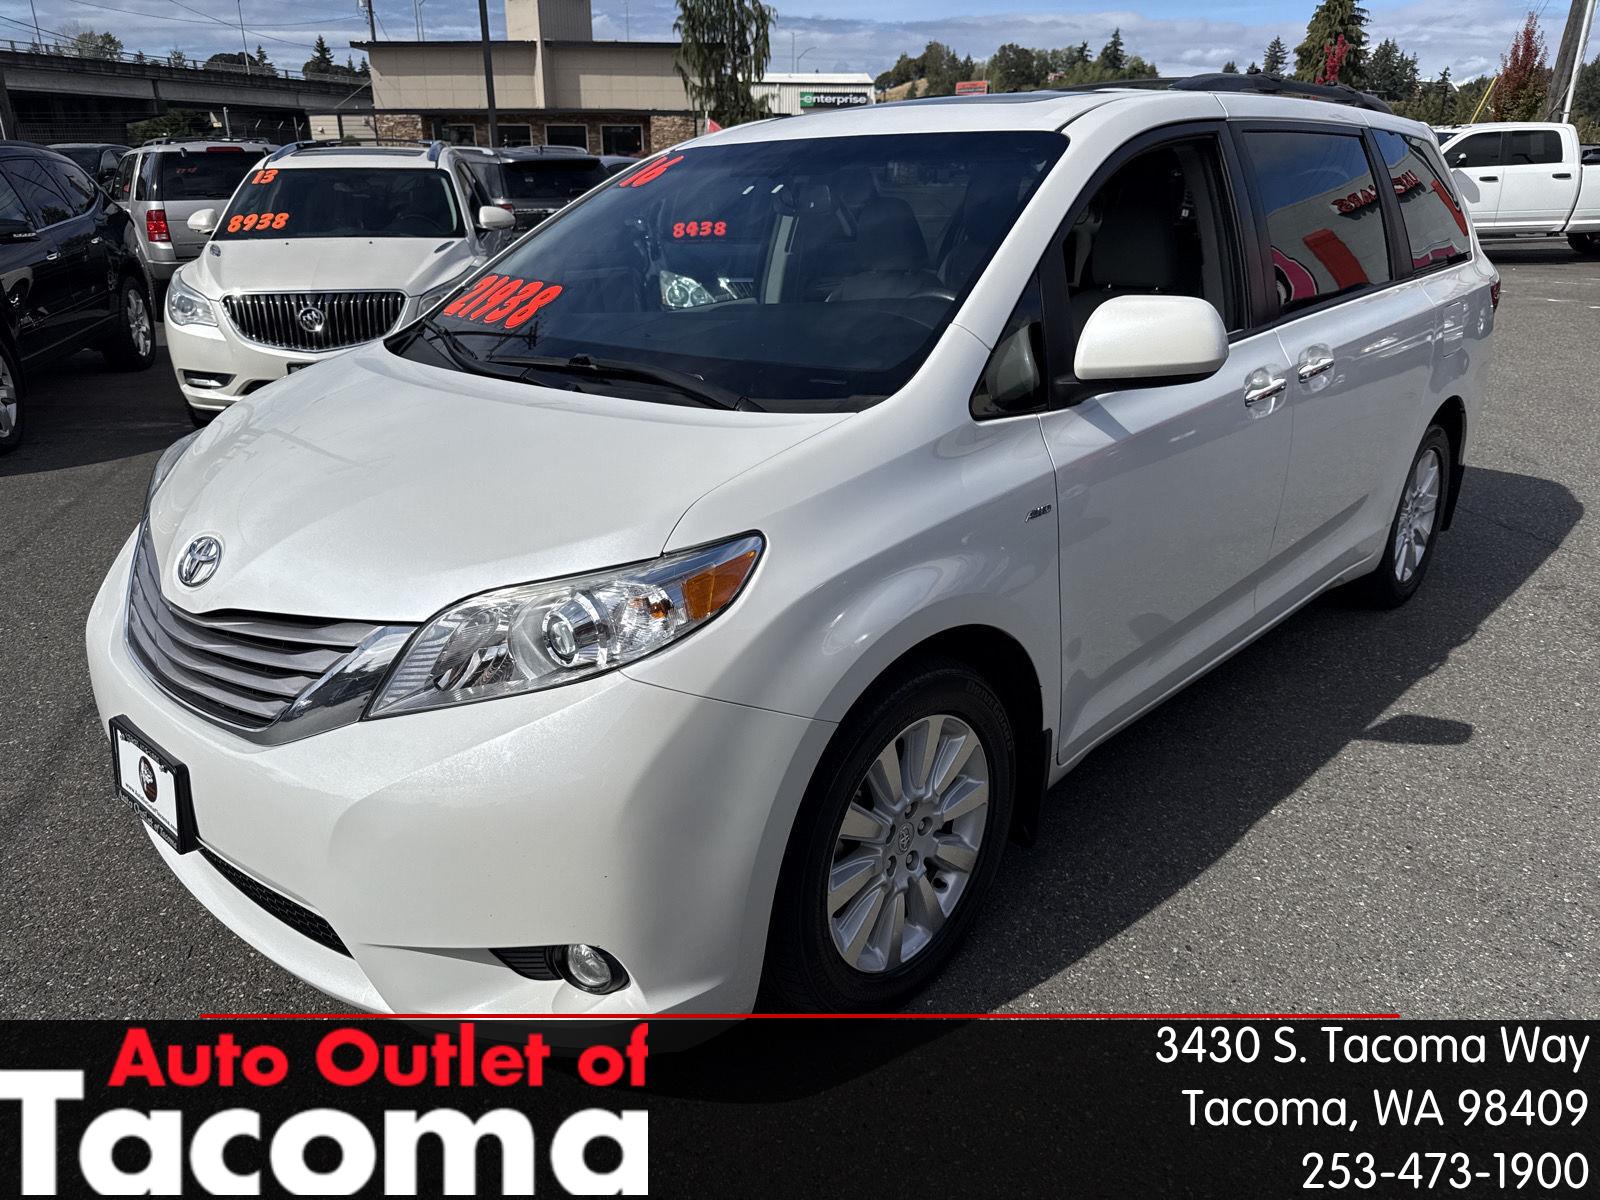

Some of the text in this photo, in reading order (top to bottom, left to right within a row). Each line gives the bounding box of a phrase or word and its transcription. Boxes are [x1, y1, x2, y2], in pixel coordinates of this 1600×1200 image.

[801, 94, 867, 106] enterprise
[251, 169, 279, 185] 13
[619, 155, 685, 188] 16
[226, 212, 290, 233] 8938
[672, 220, 727, 239] 8438
[443, 275, 563, 329] 21938
